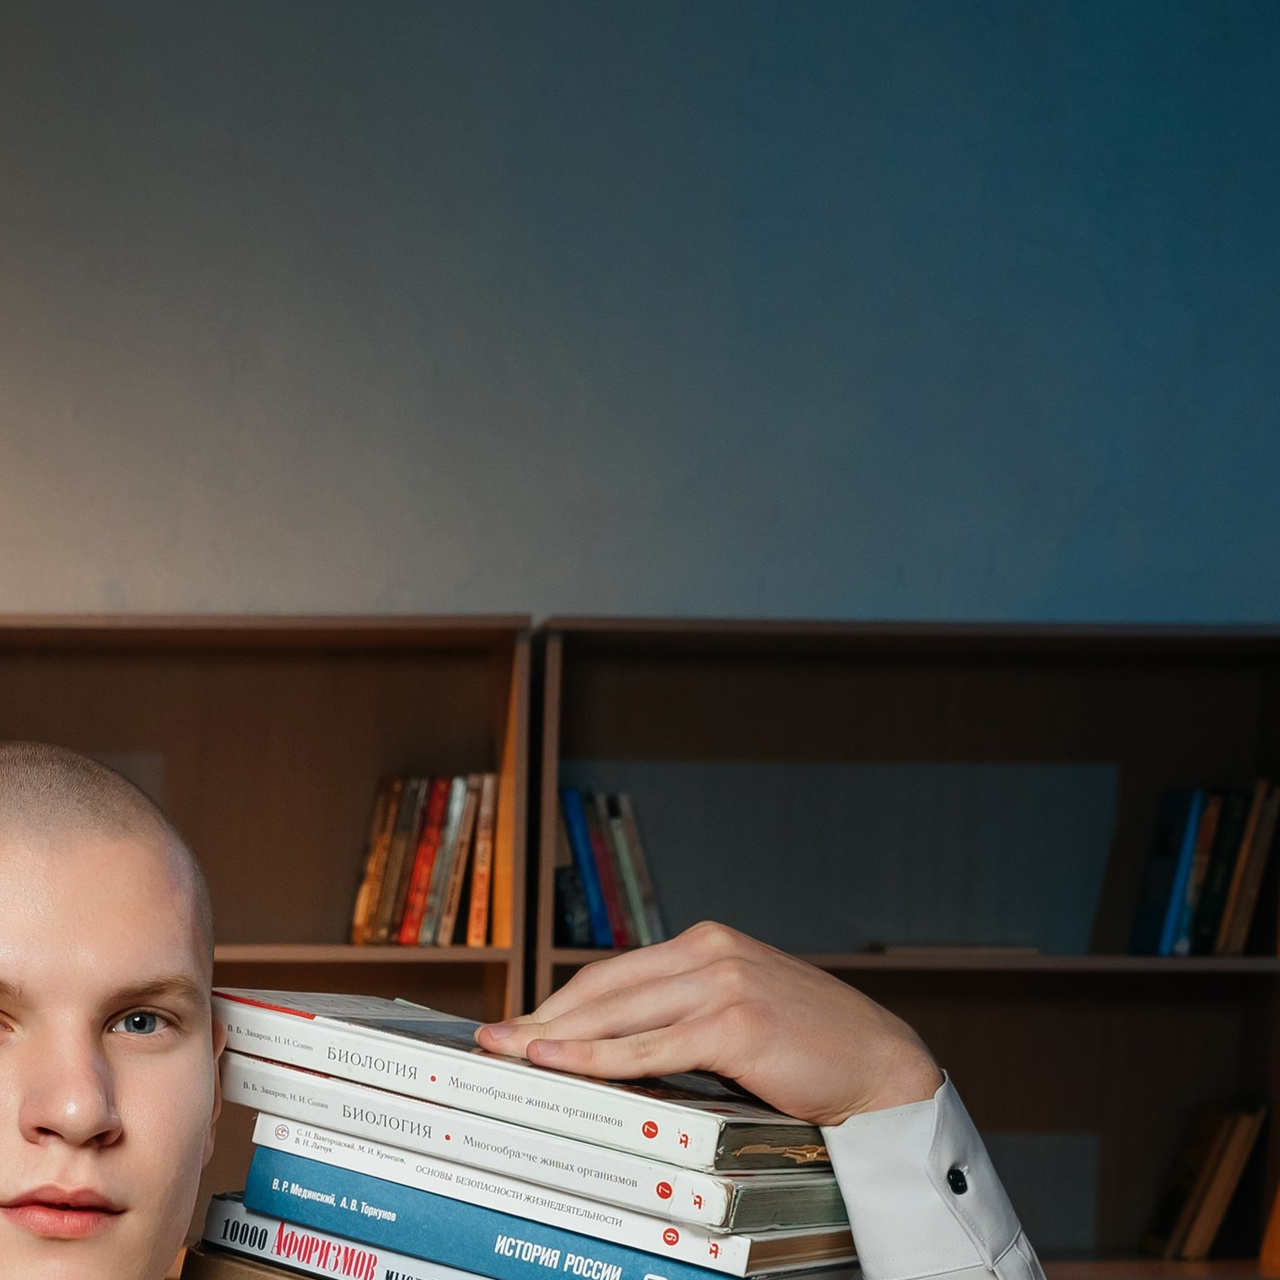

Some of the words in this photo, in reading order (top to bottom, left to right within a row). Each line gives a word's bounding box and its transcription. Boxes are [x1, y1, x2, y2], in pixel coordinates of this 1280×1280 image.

[227, 1024, 235, 1032] В.
[236, 1026, 244, 1035] Б.
[327, 1046, 418, 1080] БИОЛОГИЯ
[243, 1081, 250, 1089] В.
[251, 1084, 259, 1092] Б.
[448, 1075, 523, 1104] Многообразие
[525, 1094, 560, 1113] живых
[562, 1106, 623, 1128] организмов
[342, 1105, 432, 1139] БИОЛОГИЯ
[540, 1154, 575, 1172] живых
[577, 1166, 638, 1188] организмов
[272, 1178, 280, 1190] В.
[282, 1180, 289, 1193] Р.
[290, 1183, 336, 1207] Мединский,
[340, 1197, 348, 1209] А.
[350, 1199, 358, 1211] В.
[361, 1202, 397, 1222] Торкунов
[415, 1165, 453, 1181] ОСНОВЫ
[455, 1175, 522, 1200] БЕЗОПАСНОСТИ
[523, 1193, 623, 1227] ЖИЗНЕДЕЯТЕЛЬНОСТИ
[220, 1218, 268, 1250] 10000
[494, 1234, 561, 1270] ИСТОРИЯ
